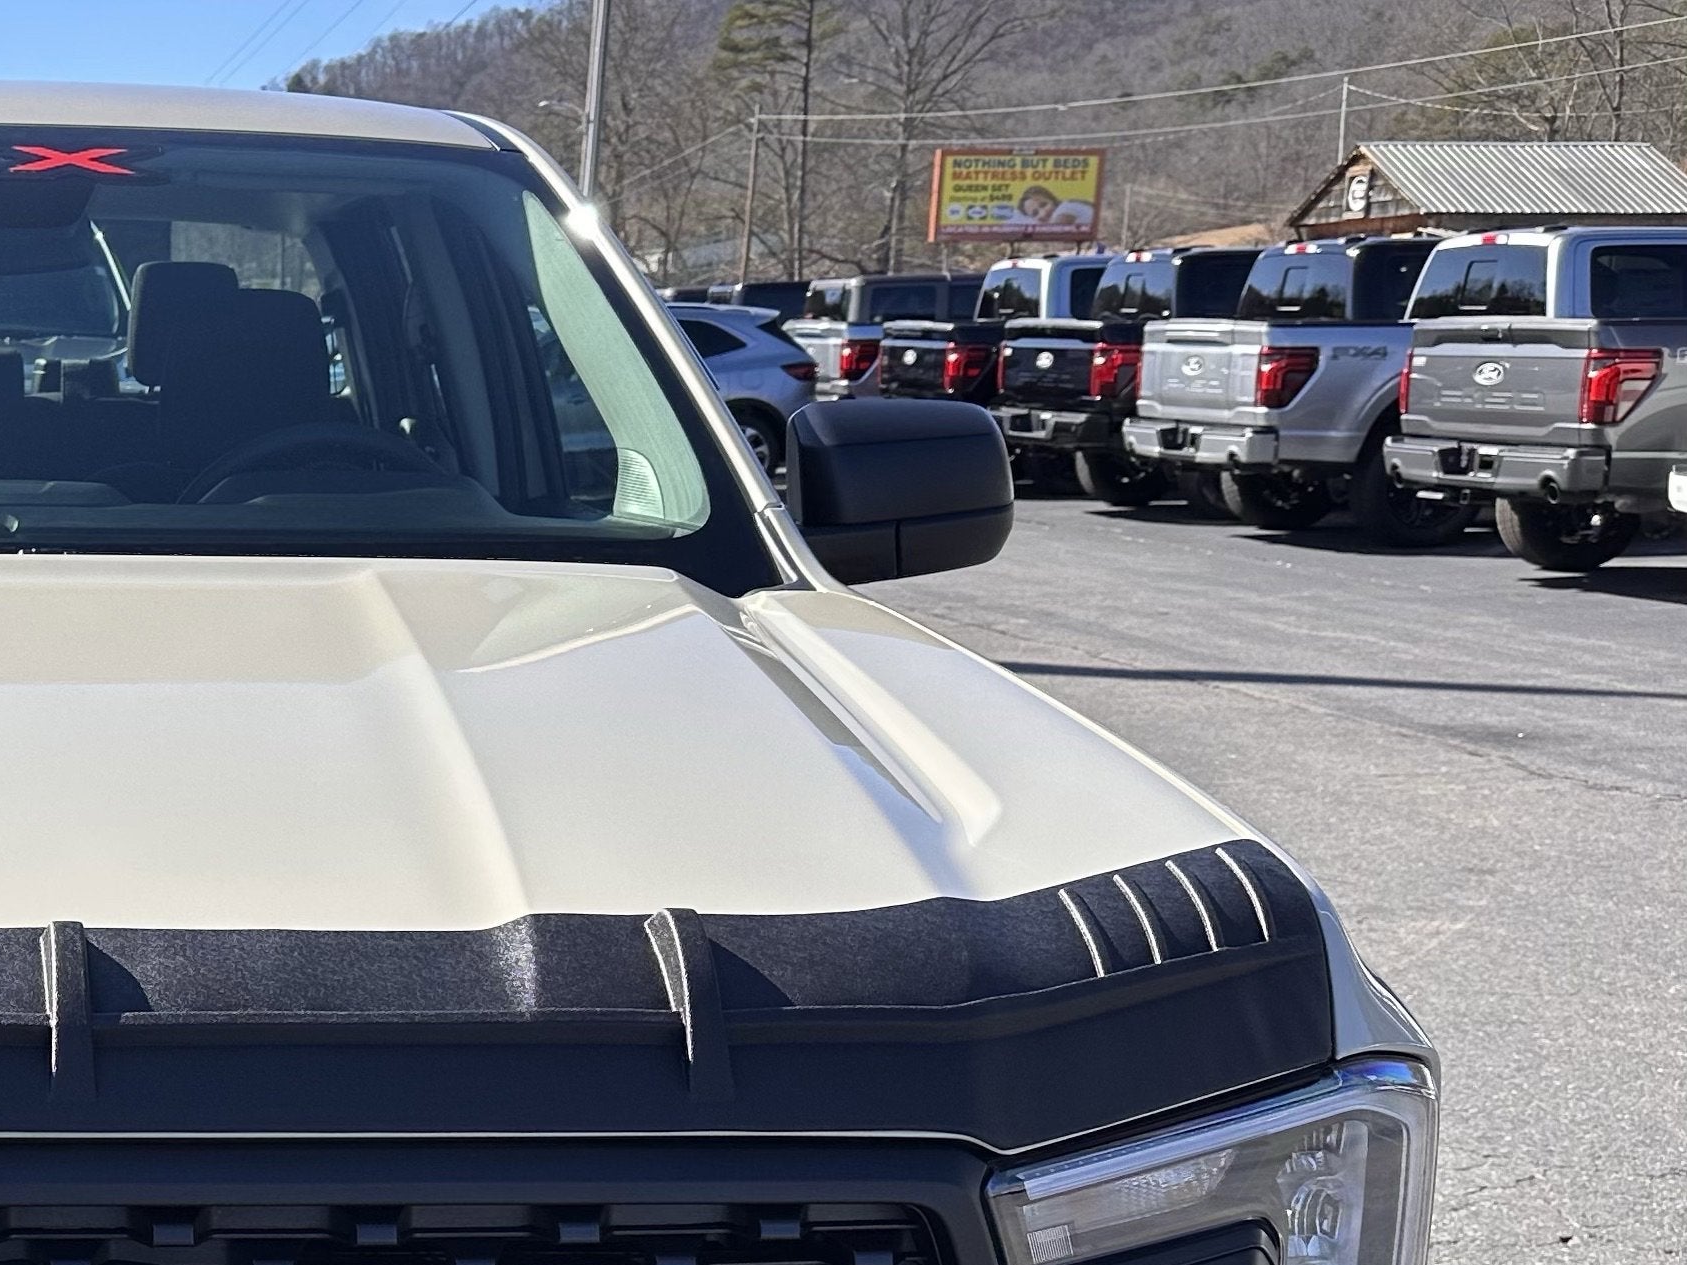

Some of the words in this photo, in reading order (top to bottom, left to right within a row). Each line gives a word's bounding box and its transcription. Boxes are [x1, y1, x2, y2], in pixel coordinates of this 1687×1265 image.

[952, 158, 1016, 169] NOTHING
[1021, 158, 1048, 169] BUT
[1053, 158, 1089, 169] BEDS
[951, 170, 1027, 181] MATTRESS
[1032, 170, 1088, 181] OUTLET
[953, 184, 989, 193] QUEEN
[991, 184, 1011, 193] SET
